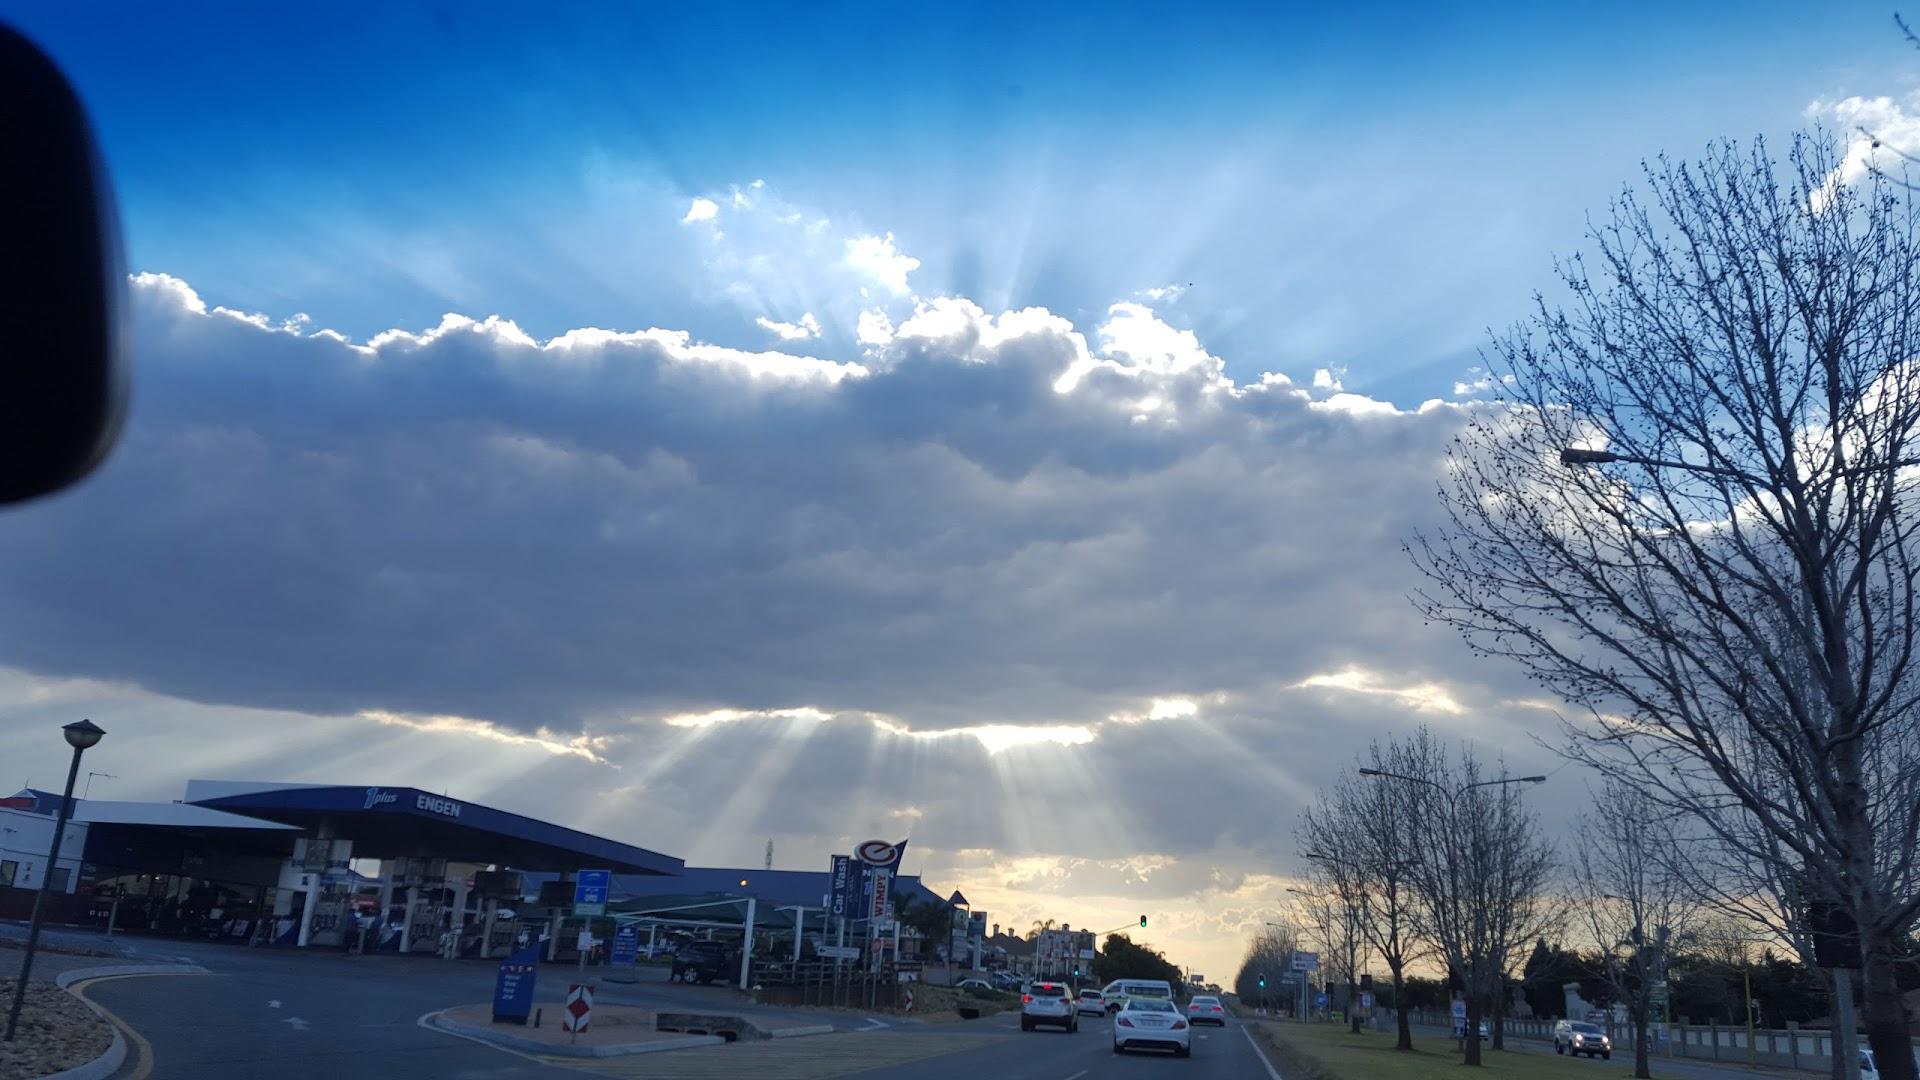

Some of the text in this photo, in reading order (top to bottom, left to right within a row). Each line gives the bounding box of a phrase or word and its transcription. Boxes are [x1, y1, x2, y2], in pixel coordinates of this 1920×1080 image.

[416, 794, 461, 817] ENGEN
[833, 858, 847, 914] Car Wash
[874, 876, 887, 917] WIMPY
